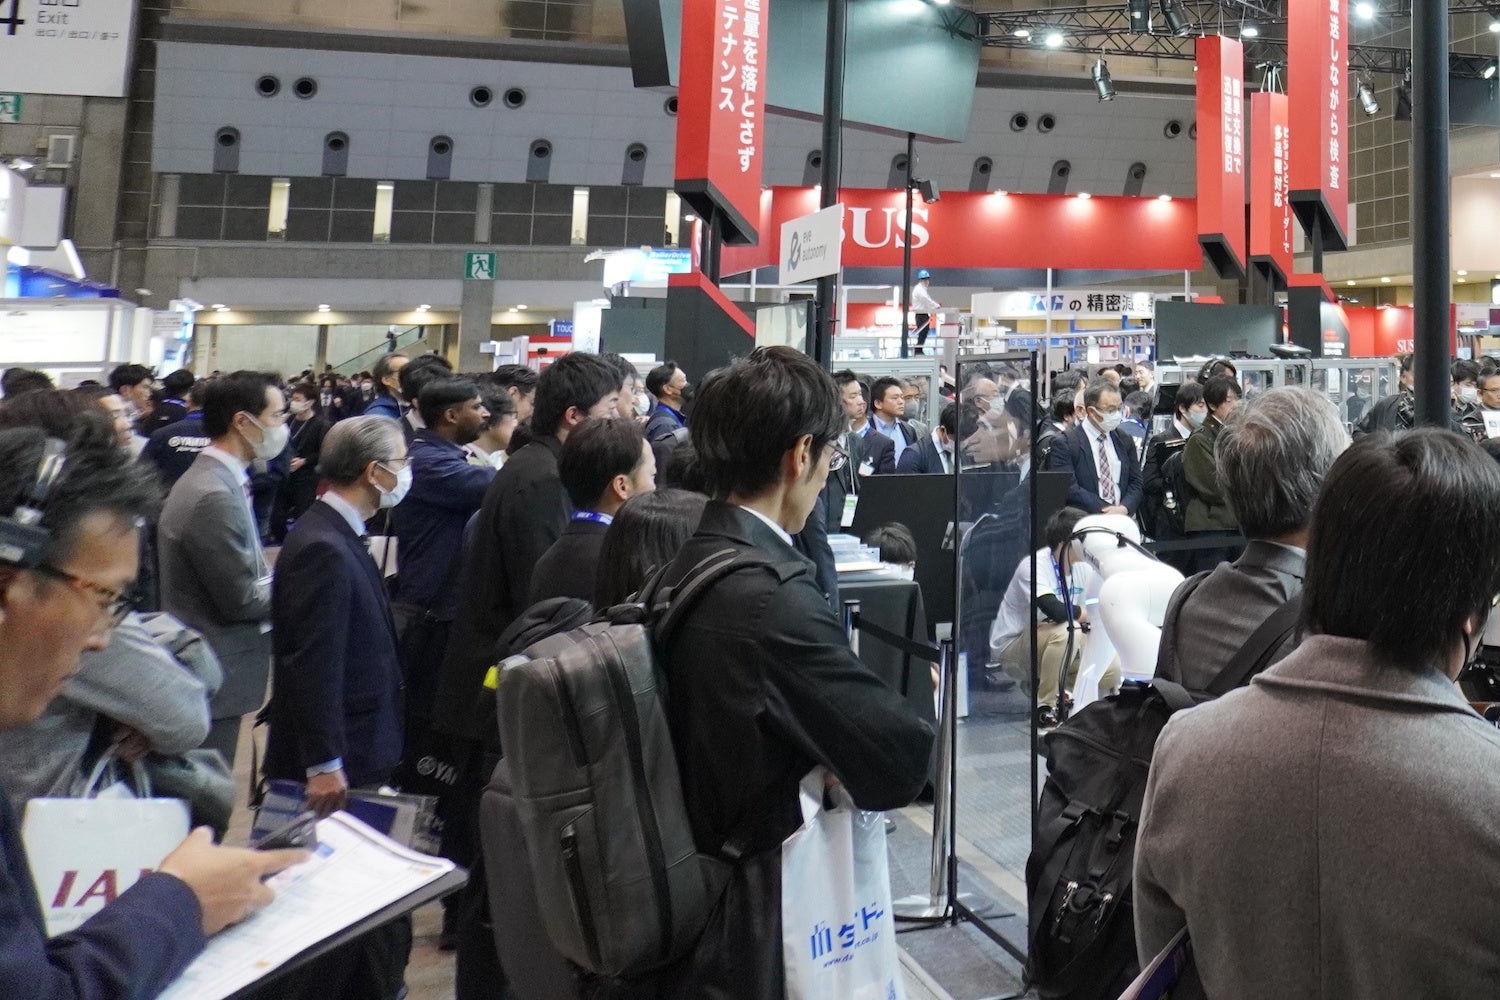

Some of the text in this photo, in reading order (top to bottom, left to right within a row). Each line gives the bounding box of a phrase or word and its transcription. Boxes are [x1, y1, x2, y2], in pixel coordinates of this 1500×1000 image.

[37, 10, 69, 24] Exit
[803, 230, 812, 244] eve
[841, 207, 930, 249] US
[802, 243, 827, 262] autonomy
[51, 868, 154, 909] IA
